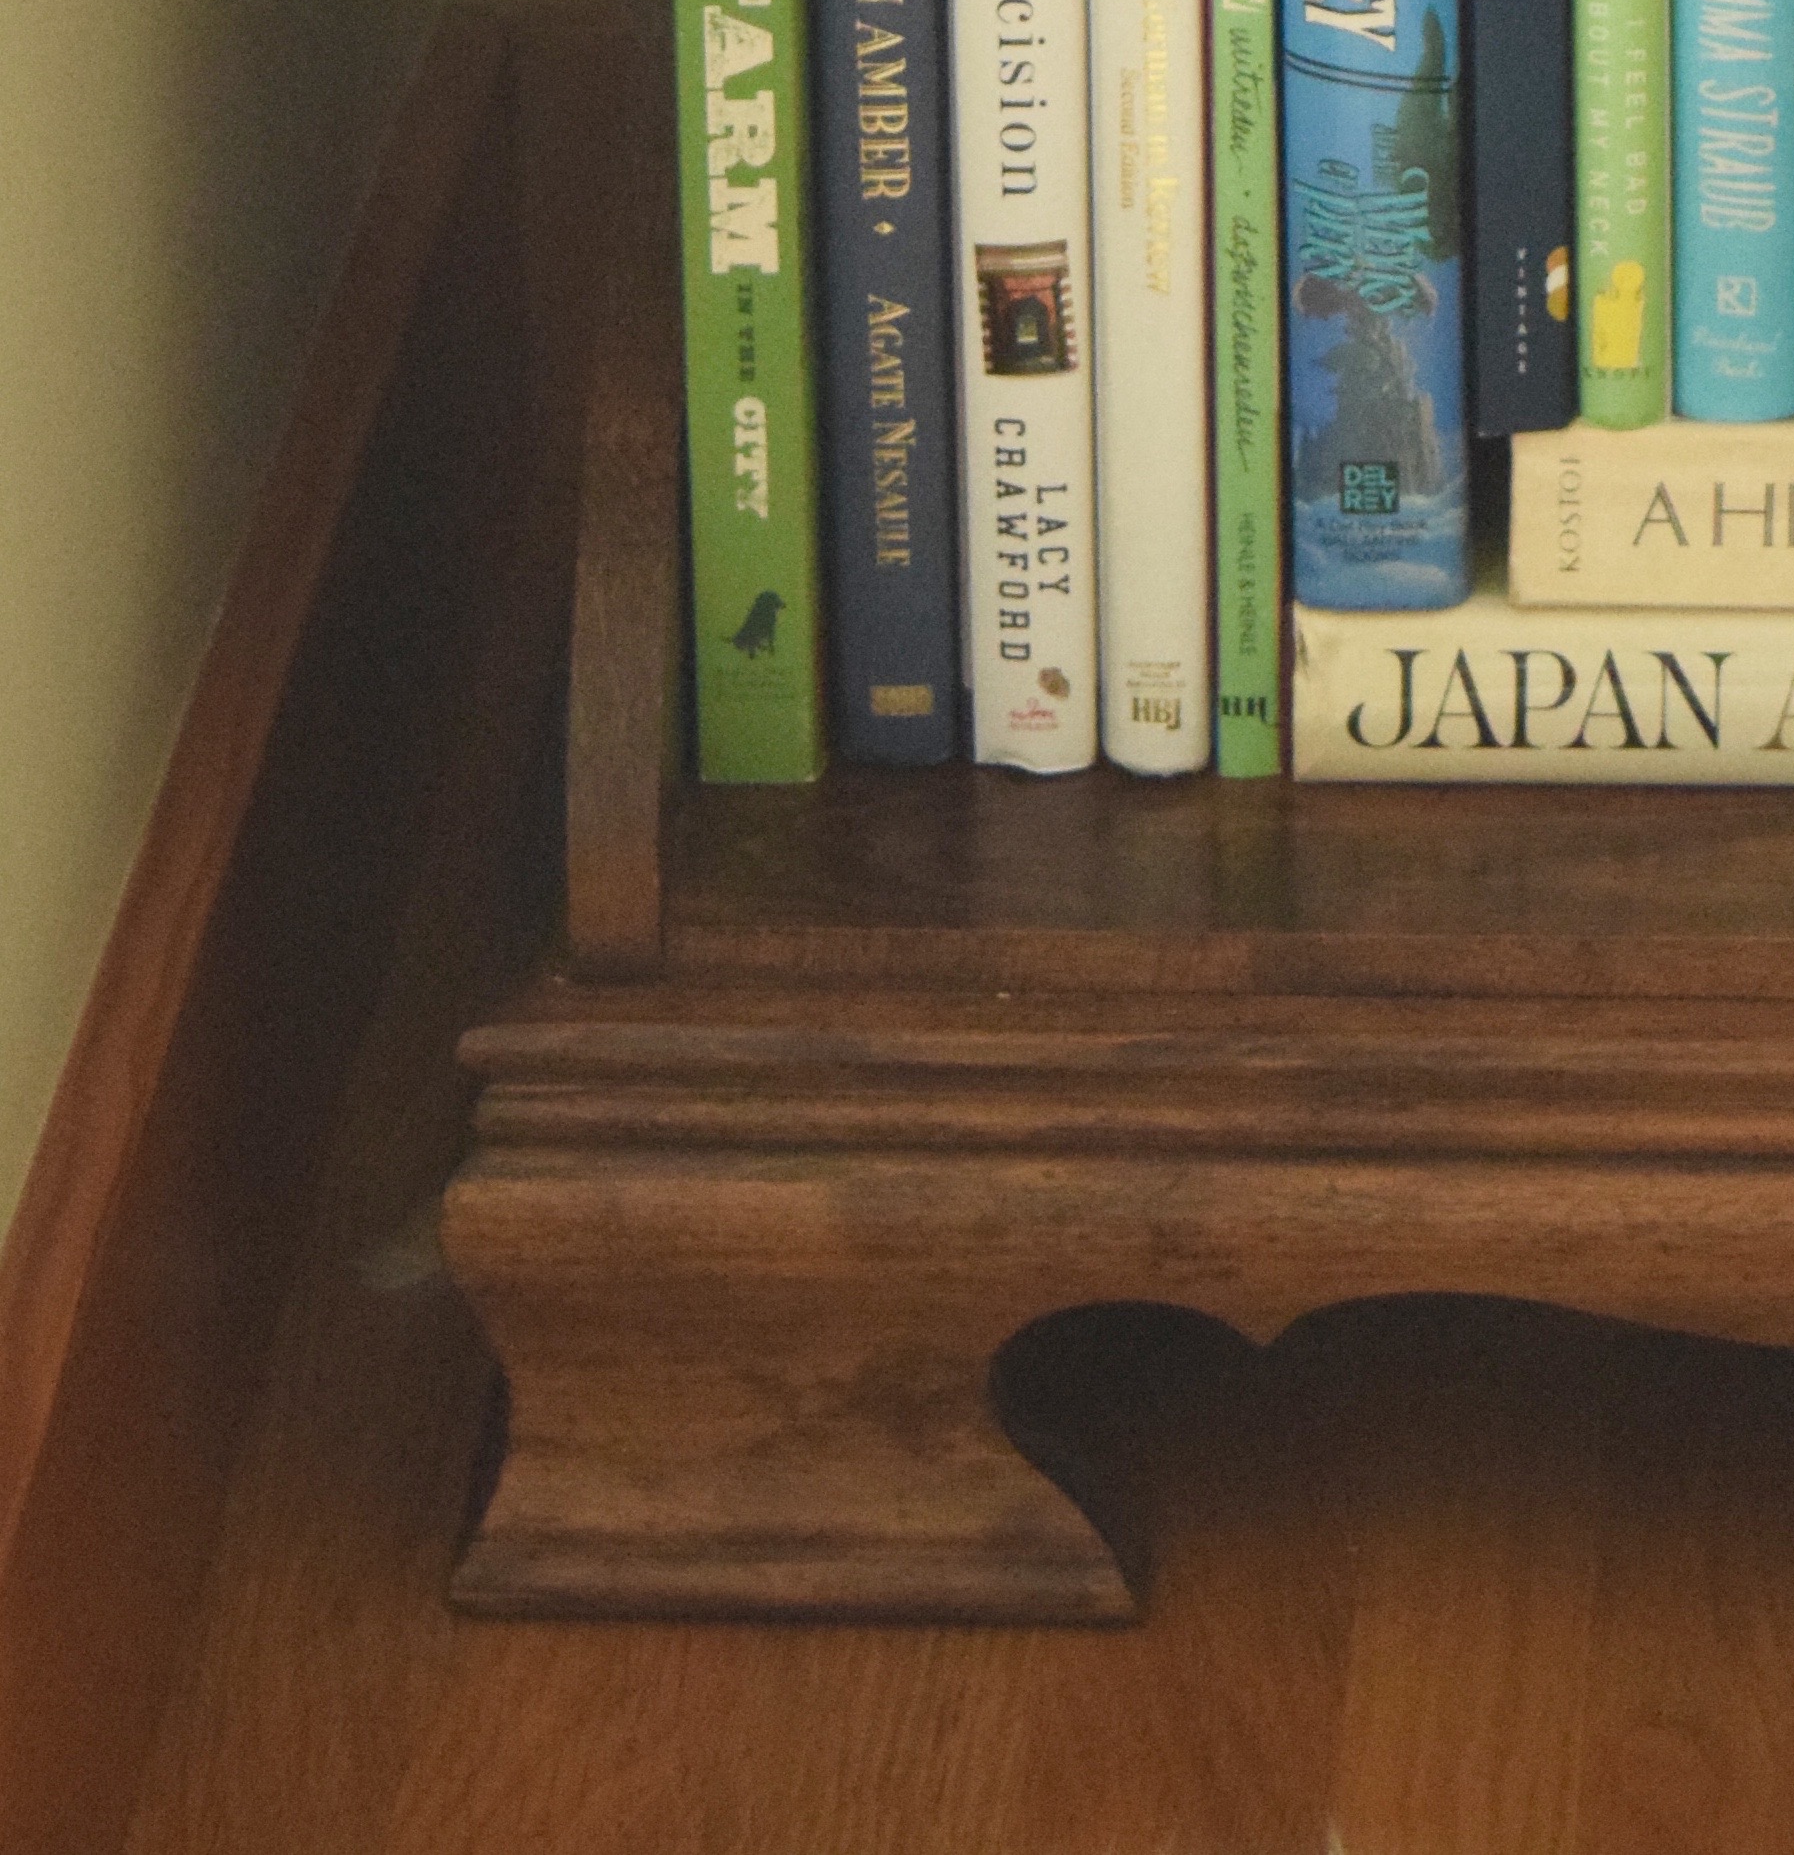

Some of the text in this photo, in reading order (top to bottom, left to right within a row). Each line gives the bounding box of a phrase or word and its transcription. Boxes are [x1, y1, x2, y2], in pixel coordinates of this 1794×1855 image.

[855, 20, 914, 202] AMBER
[1589, 108, 1611, 150] MY
[1624, 48, 1647, 131] FEEL
[1625, 151, 1648, 215] BAD
[1698, 78, 1780, 233] STRAUB
[1145, 176, 1181, 296] Review
[1589, 170, 1611, 258] NECK
[735, 283, 754, 316] IN
[737, 324, 756, 383] THE
[732, 396, 769, 520] CITY
[1343, 464, 1395, 486] DEL
[1343, 488, 1395, 510] REY
[992, 417, 1032, 664] CRAWFORD
[1035, 483, 1071, 597] LACY
[1632, 481, 1689, 547] A
[1346, 647, 1736, 751] JAPAN
